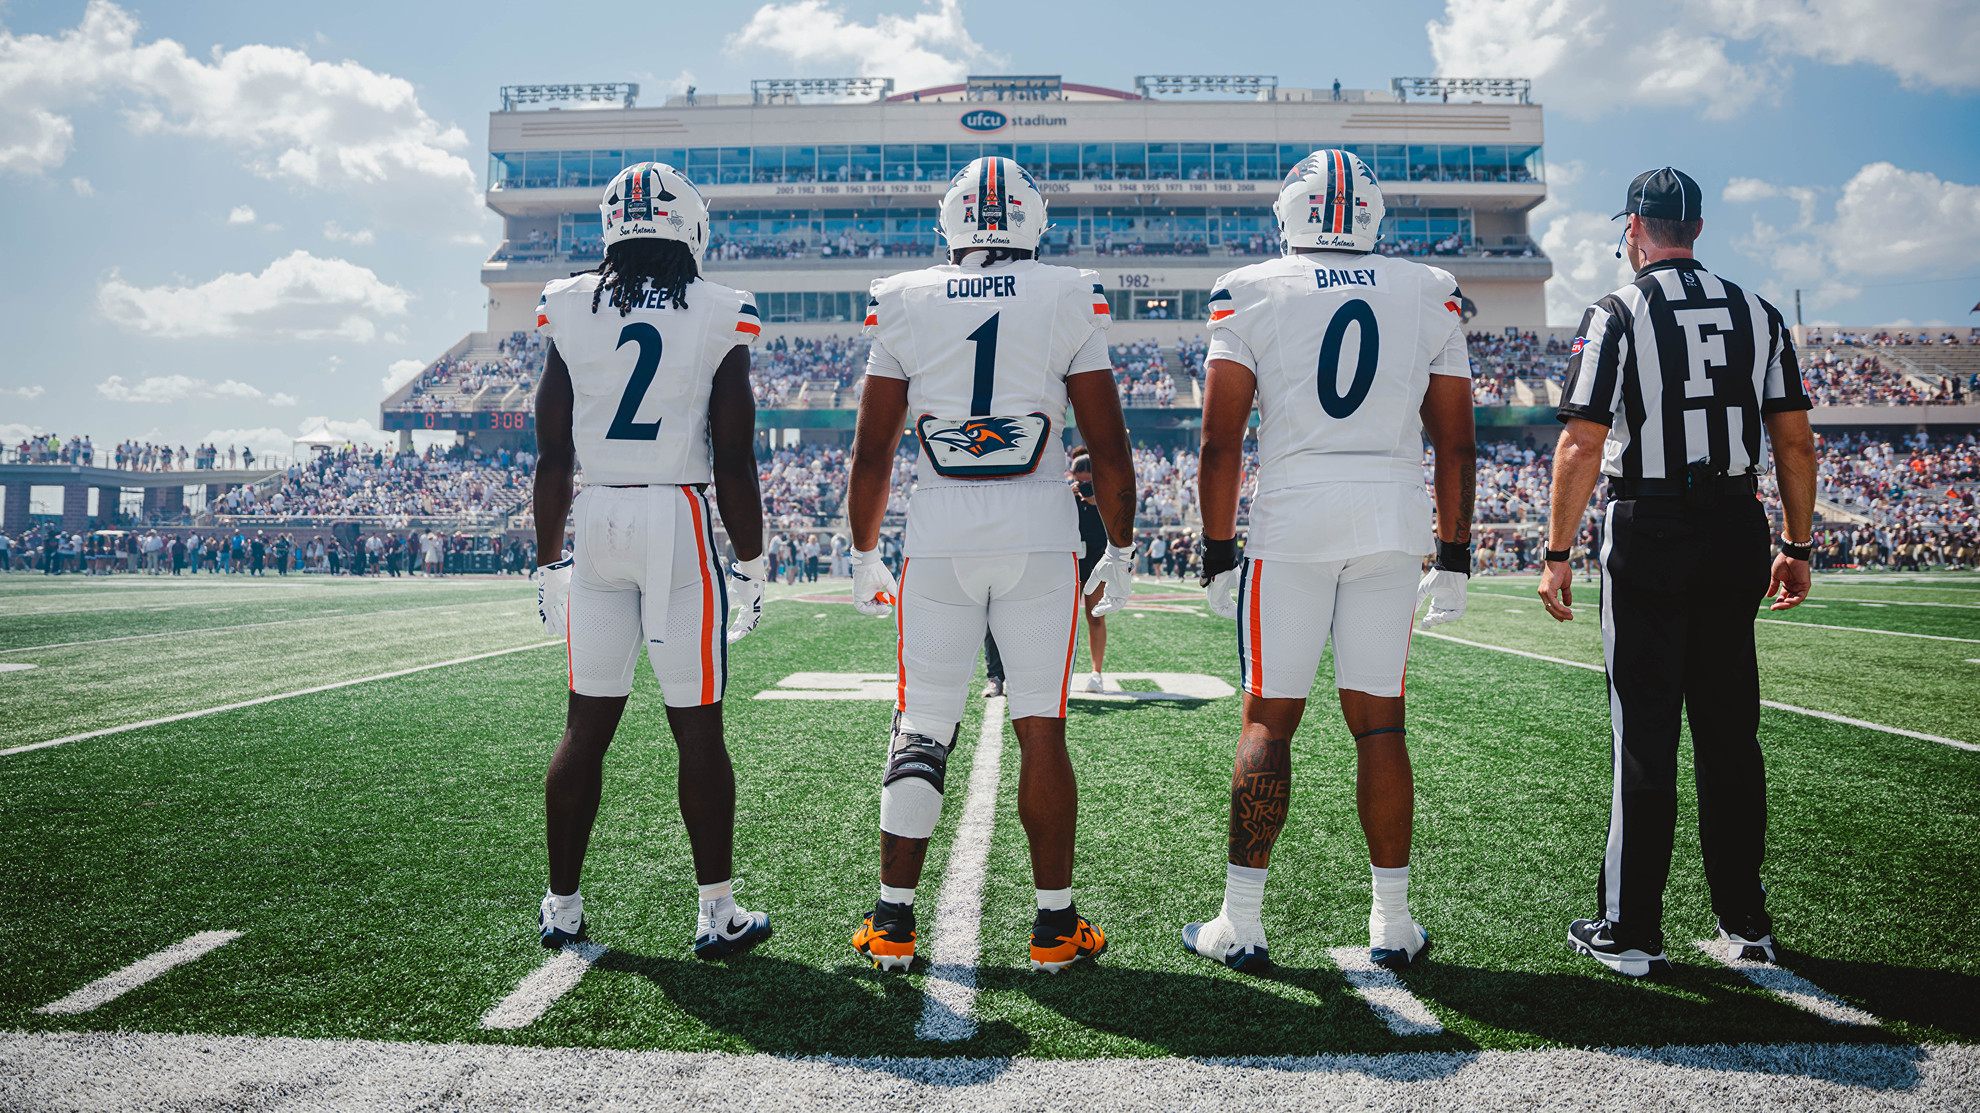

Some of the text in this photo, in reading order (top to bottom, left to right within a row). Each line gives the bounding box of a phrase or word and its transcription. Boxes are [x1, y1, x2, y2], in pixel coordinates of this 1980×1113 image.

[967, 112, 1067, 127] ufcu stadium
[776, 186, 794, 195] 2005
[798, 186, 816, 194] 1982
[914, 184, 932, 192] 1921
[1094, 183, 1112, 192] 1924
[1237, 183, 1255, 192] 2008
[619, 223, 657, 236] San Antonio
[972, 233, 1011, 245] San Antonio
[1316, 235, 1355, 247] San Antonio
[946, 275, 1016, 299] COOPER
[1118, 274, 1149, 288] 1982
[1314, 268, 1377, 289] BAILEY
[608, 287, 669, 310] WEE
[1317, 298, 1380, 420] 0
[1673, 307, 1734, 399] F
[965, 310, 1000, 417] 1
[605, 321, 663, 441] 2
[425, 412, 524, 429] 0 3:08
[1246, 772, 1289, 798] THE
